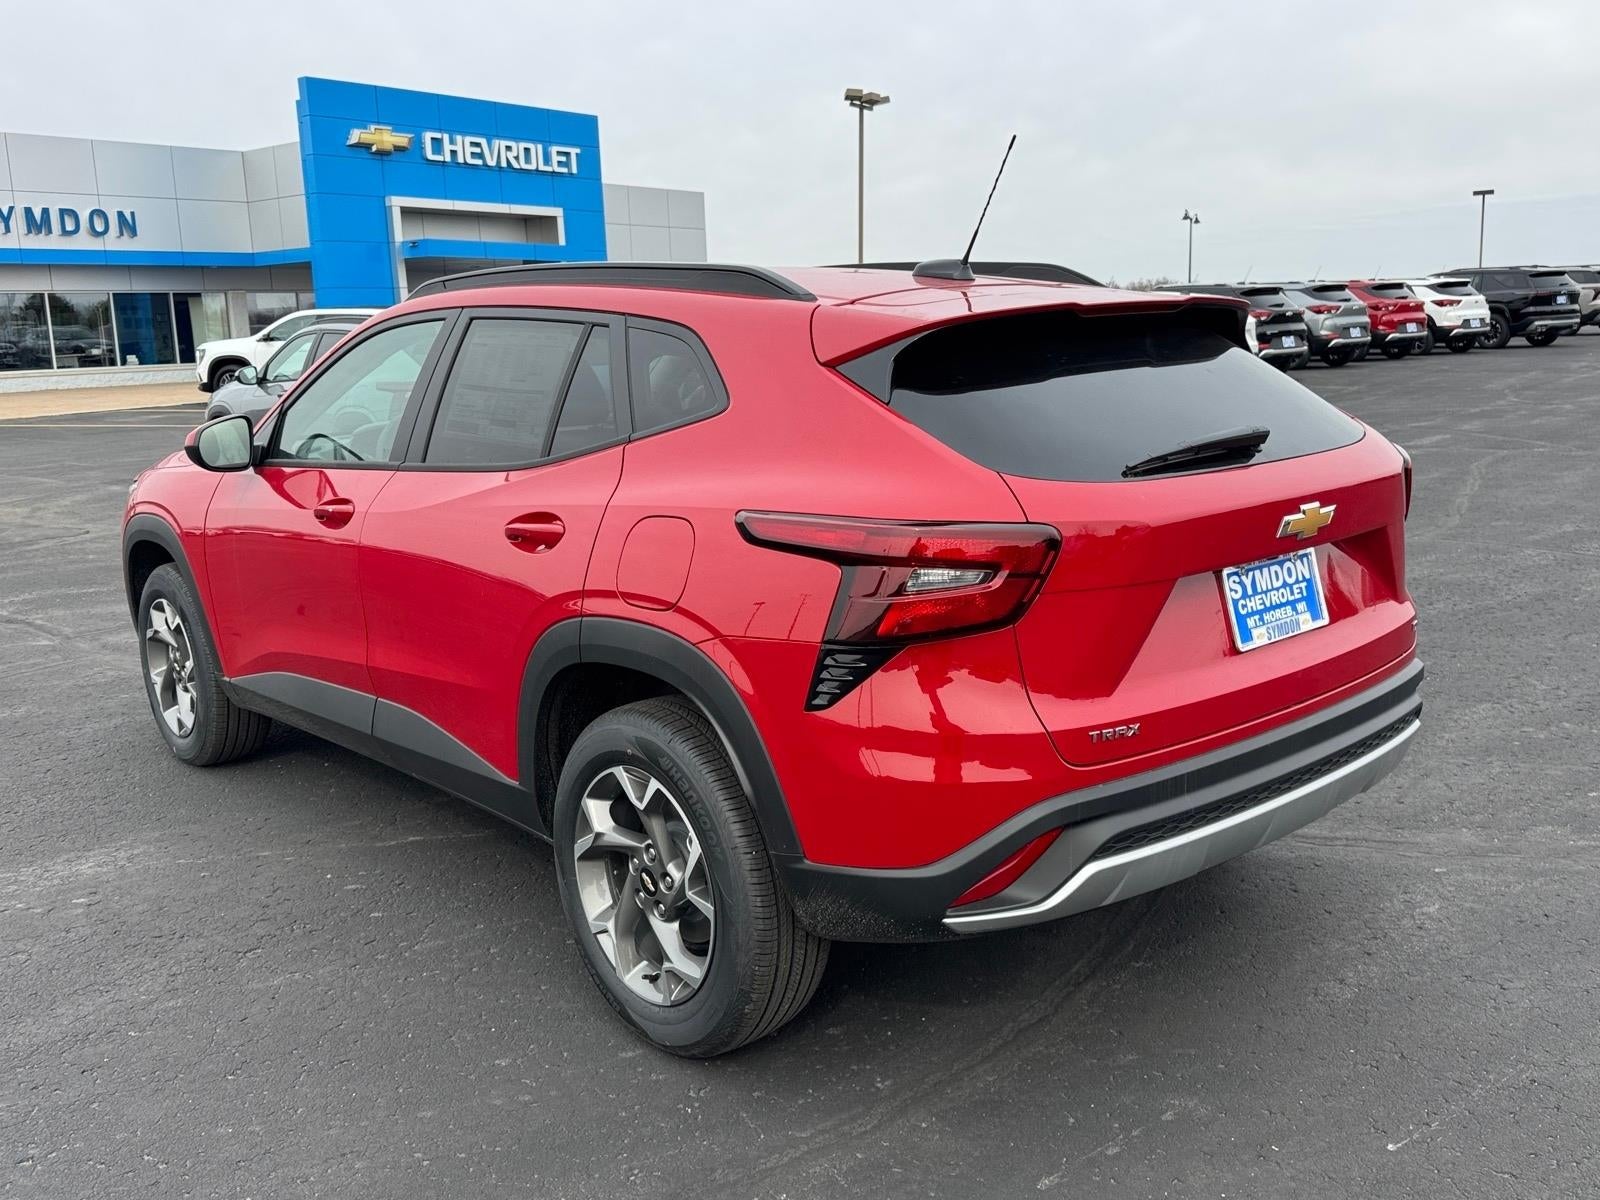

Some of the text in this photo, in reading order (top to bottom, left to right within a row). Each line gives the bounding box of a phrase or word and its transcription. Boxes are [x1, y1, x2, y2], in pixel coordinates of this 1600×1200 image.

[422, 131, 581, 175] CHEVROLET
[1228, 556, 1311, 600] SYMDON
[1237, 582, 1307, 615] CHEVROLET
[1246, 600, 1308, 629] MT. HOREB, WI
[1265, 617, 1302, 642] SYMDON
[1088, 722, 1141, 744] TRAX
